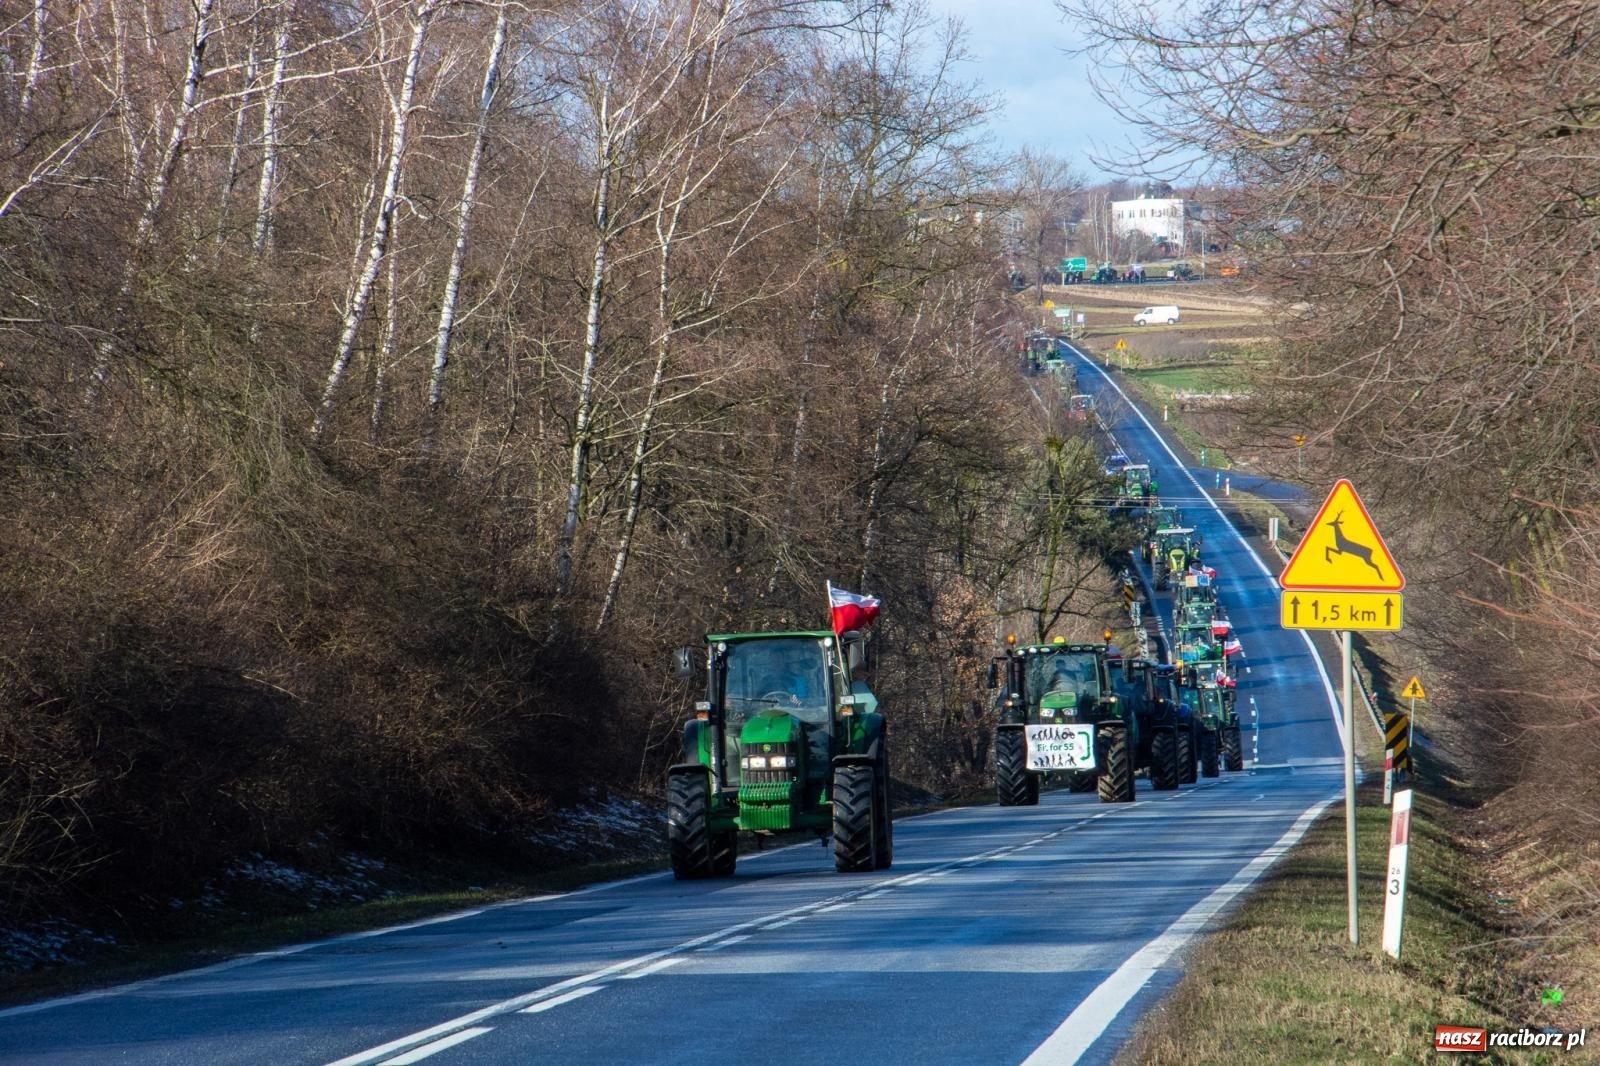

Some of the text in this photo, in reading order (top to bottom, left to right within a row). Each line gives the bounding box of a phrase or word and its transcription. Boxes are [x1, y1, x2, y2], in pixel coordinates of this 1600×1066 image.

[1311, 600, 1376, 623] 1,5 km
[1050, 743, 1062, 751] for
[1390, 879, 1400, 895] 3
